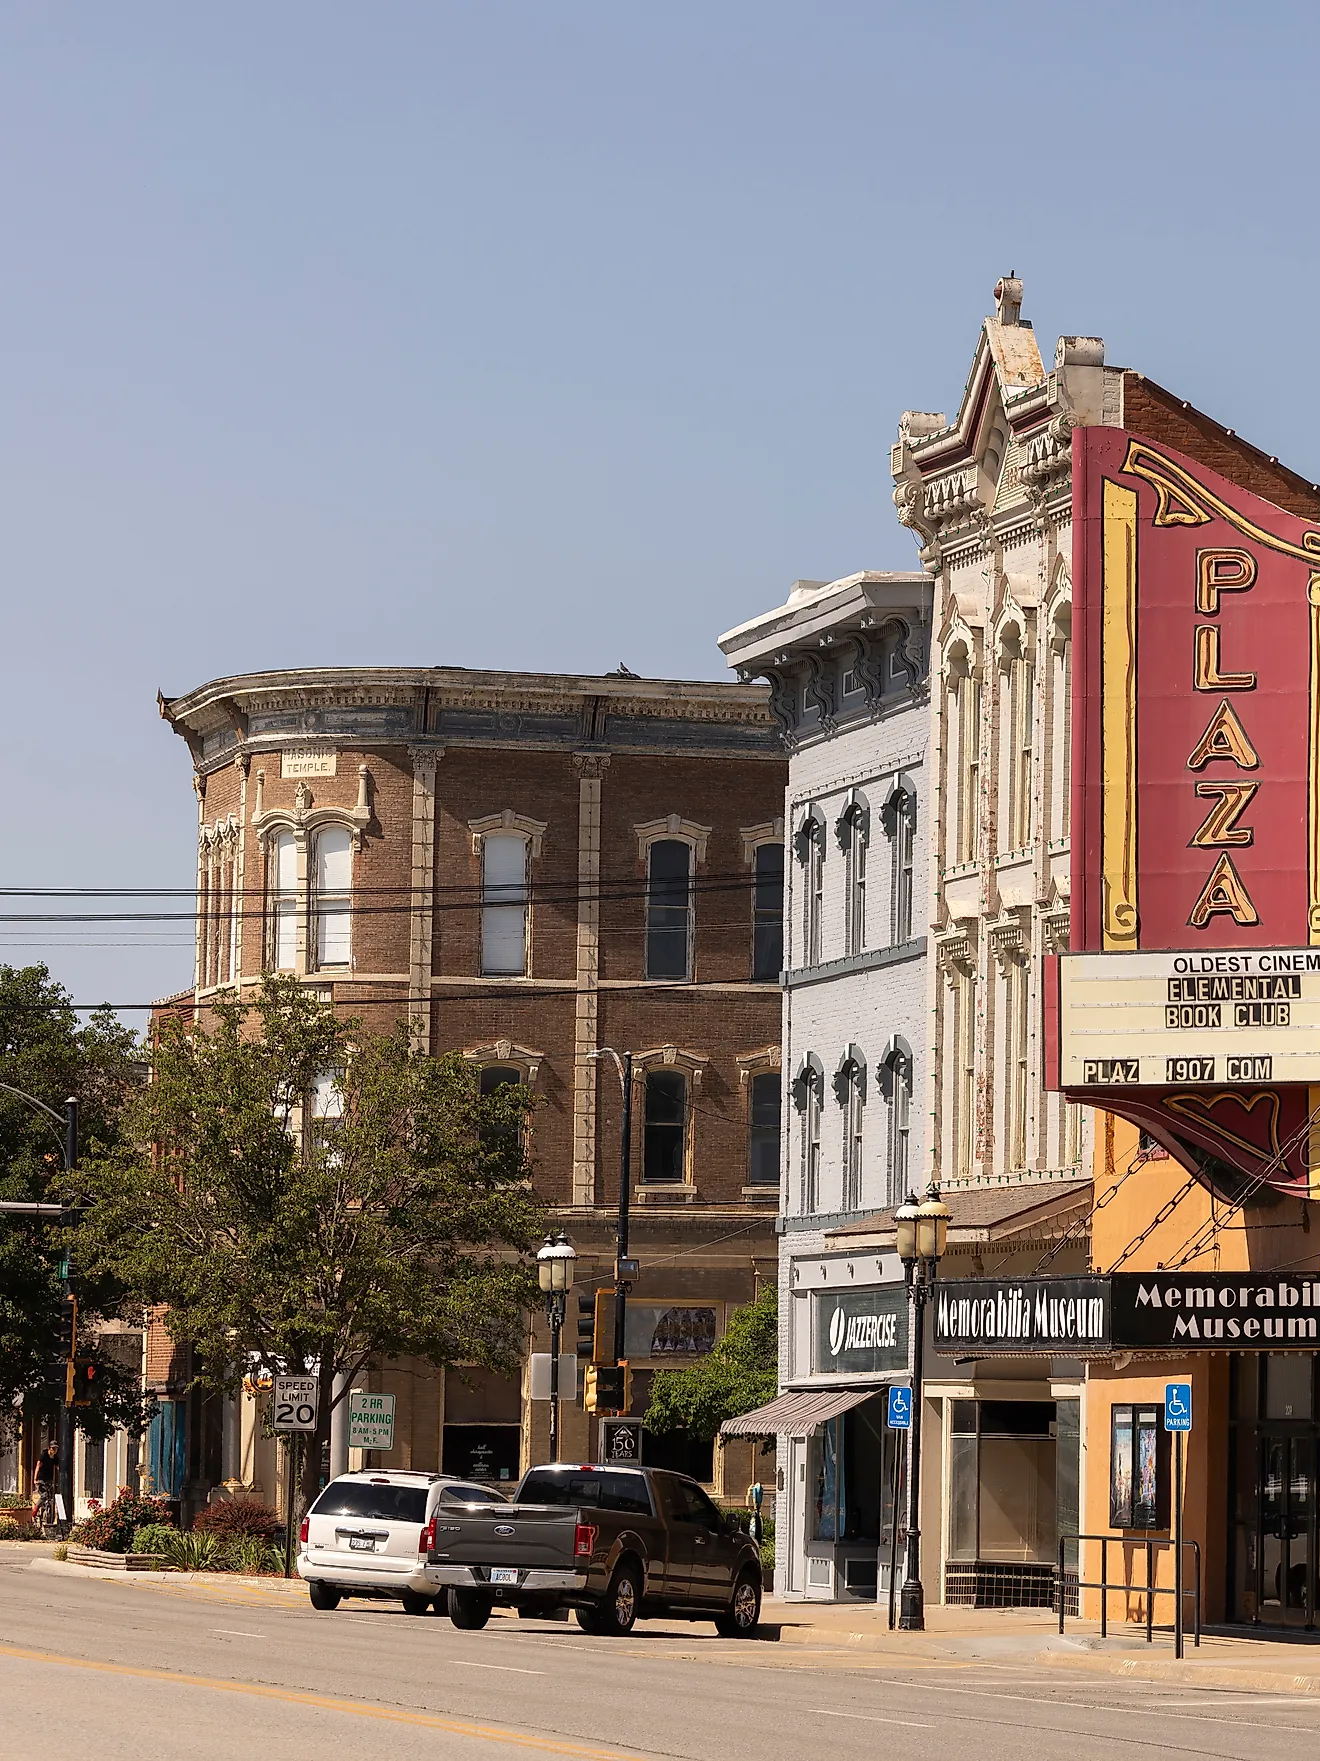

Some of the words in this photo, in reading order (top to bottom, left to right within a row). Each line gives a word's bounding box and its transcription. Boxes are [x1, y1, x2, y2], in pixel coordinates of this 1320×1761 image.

[1185, 547, 1263, 926] PLAZA
[1173, 956, 1252, 973] OLDEST
[1168, 975, 1301, 1001] ELEMENTAL
[1165, 1005, 1221, 1028] BOOK
[1234, 1003, 1290, 1026] CLUB
[1083, 1060, 1139, 1083] PLAZ
[1166, 1058, 1215, 1082] 1907
[1227, 1057, 1272, 1080] COM
[937, 1289, 1030, 1338] Memorabilia
[1033, 1289, 1104, 1338] Museum
[844, 1314, 896, 1351] JAZZERCISE
[1172, 1313, 1317, 1338] Museum
[279, 1382, 314, 1390] SPEED
[282, 1393, 309, 1401] LIMIT
[361, 1398, 367, 1409] 2
[370, 1398, 382, 1409] HR
[276, 1404, 314, 1423] 20
[351, 1412, 391, 1424] PARKING
[1166, 1418, 1189, 1426] PARKING
[612, 1436, 635, 1451] 150
[611, 1450, 633, 1458] YEARS
